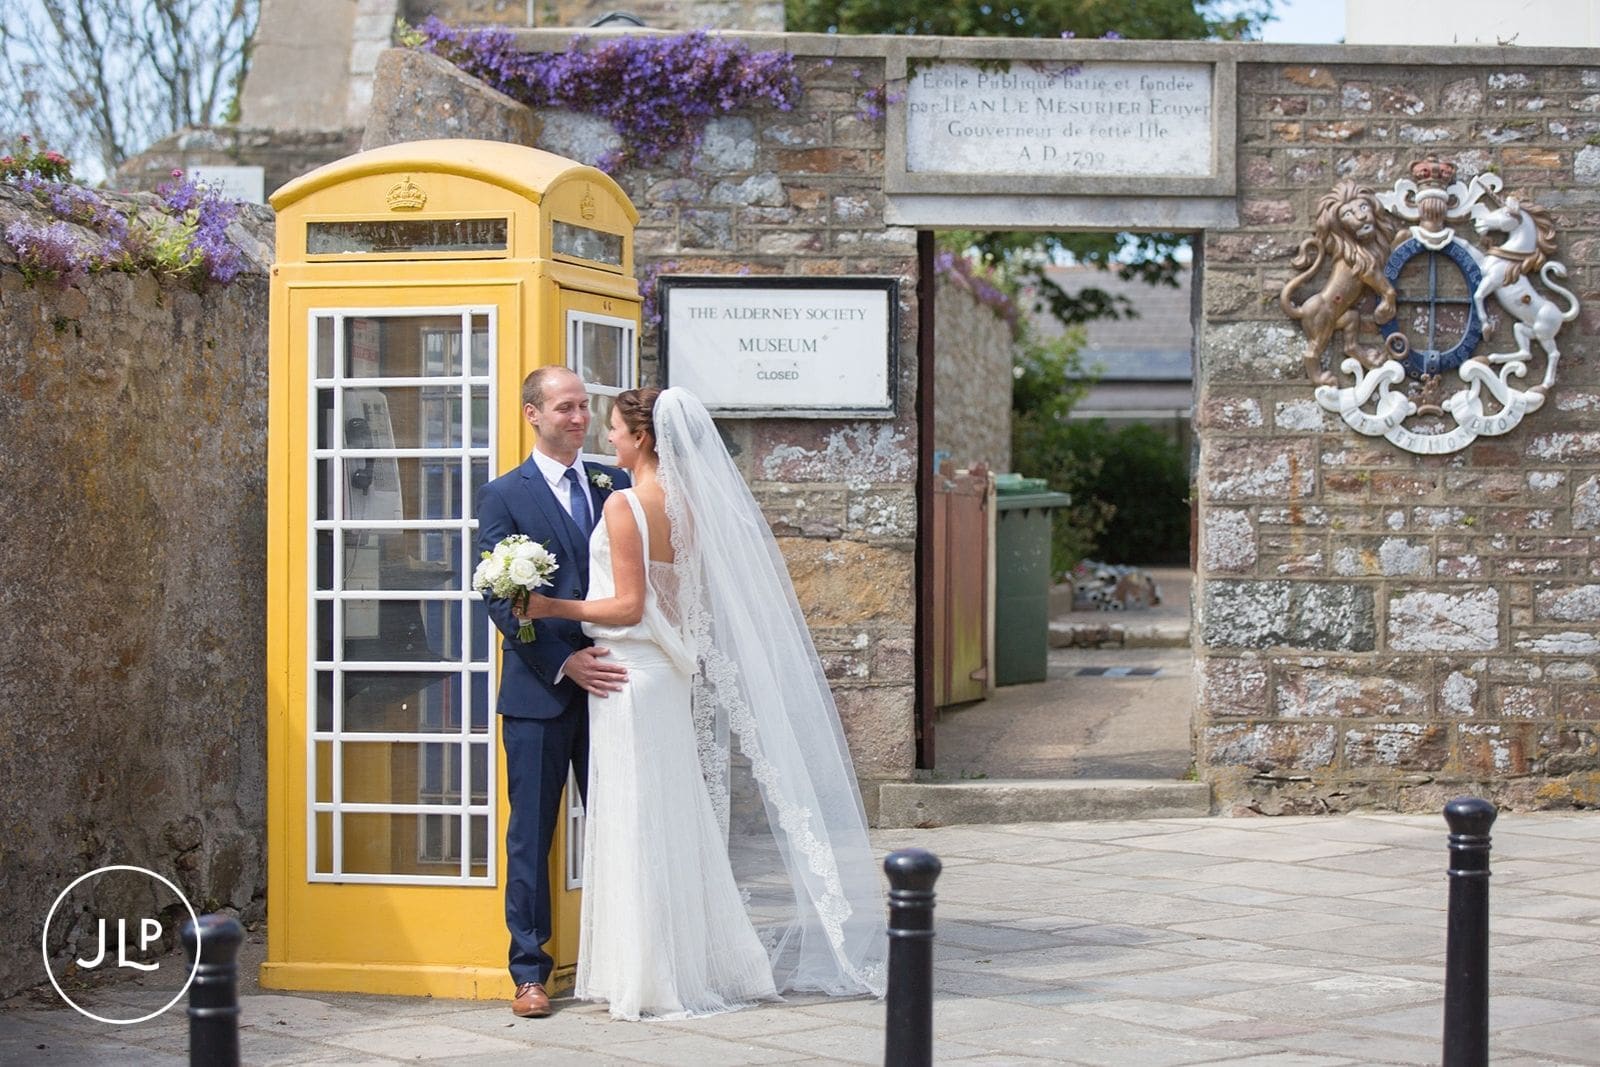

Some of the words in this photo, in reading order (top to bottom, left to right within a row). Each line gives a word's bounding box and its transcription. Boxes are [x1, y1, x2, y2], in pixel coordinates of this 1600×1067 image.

[1114, 78, 1130, 90] et
[1036, 98, 1141, 115] MESURIER
[948, 120, 1053, 138] Gouverneur
[1062, 122, 1082, 138] de
[689, 307, 717, 320] THE
[723, 308, 802, 320] ALDERNEY
[807, 308, 866, 321] SOCIETY
[738, 338, 818, 353] MUSEUM
[757, 371, 799, 381] CLOSED
